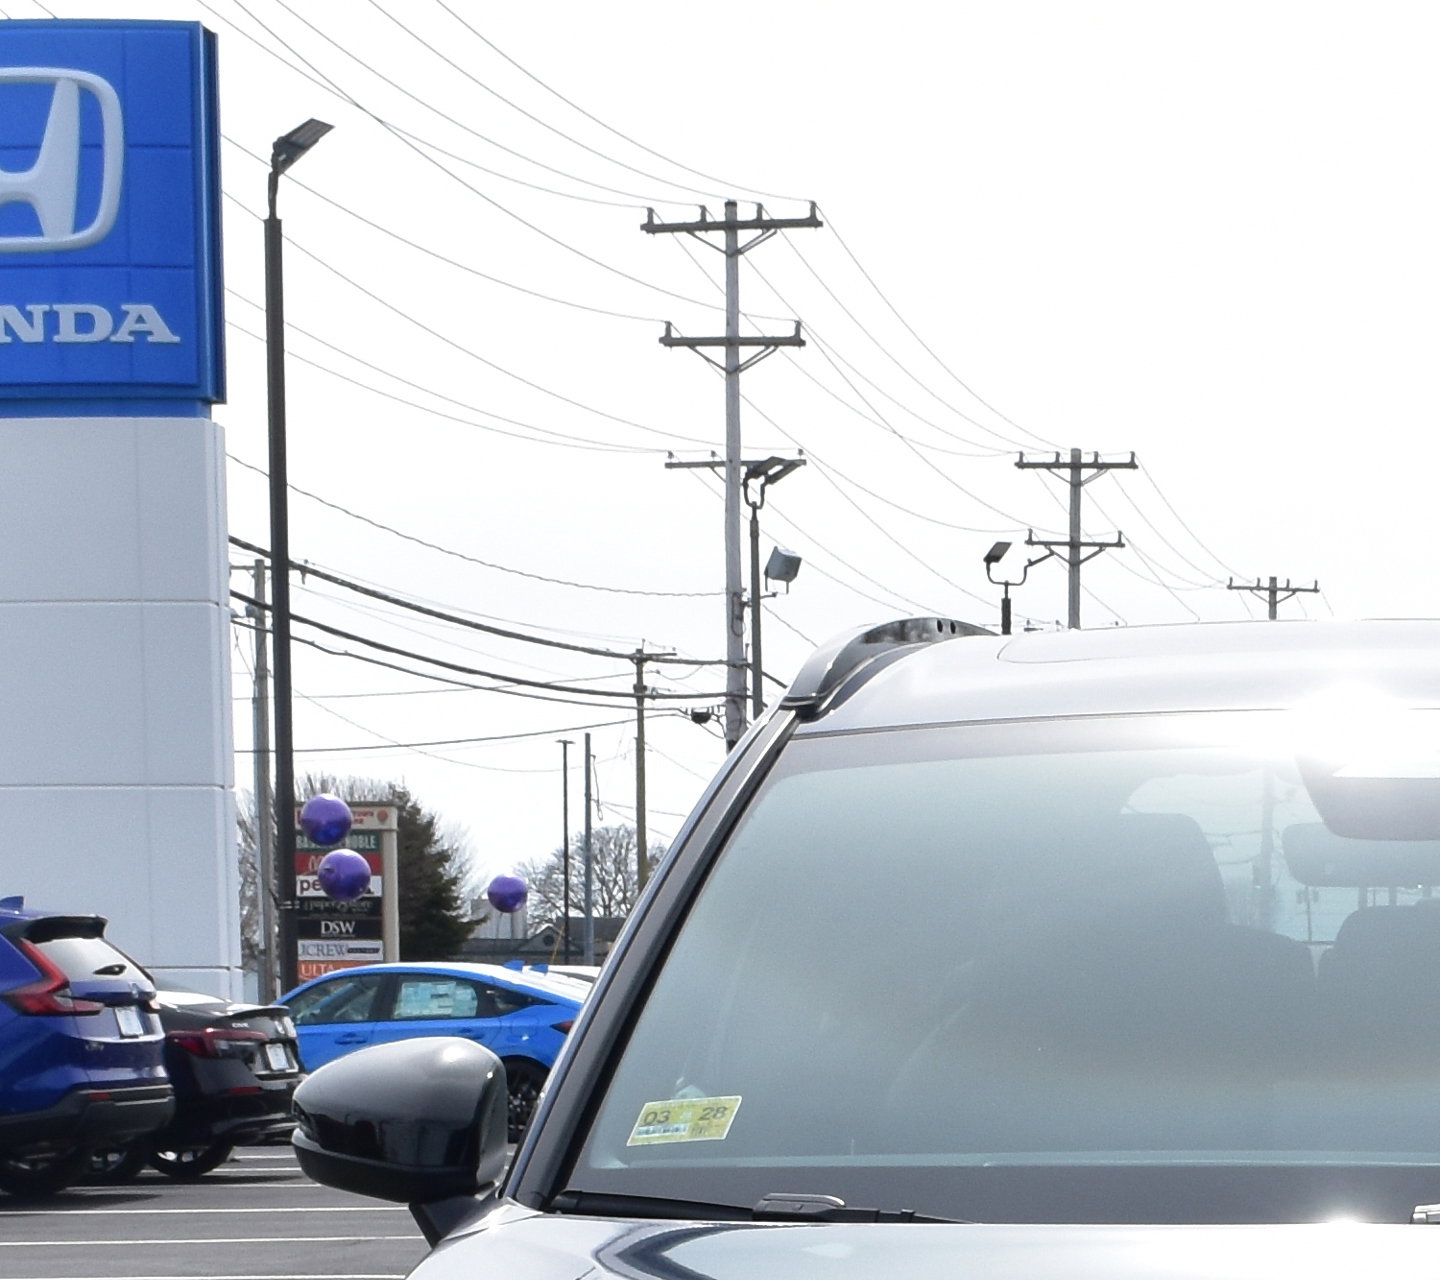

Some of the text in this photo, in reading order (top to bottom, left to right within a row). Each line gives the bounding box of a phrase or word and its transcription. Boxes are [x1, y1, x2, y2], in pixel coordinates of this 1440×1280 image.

[320, 920, 356, 935] DSW
[643, 1106, 728, 1127] 03 28
